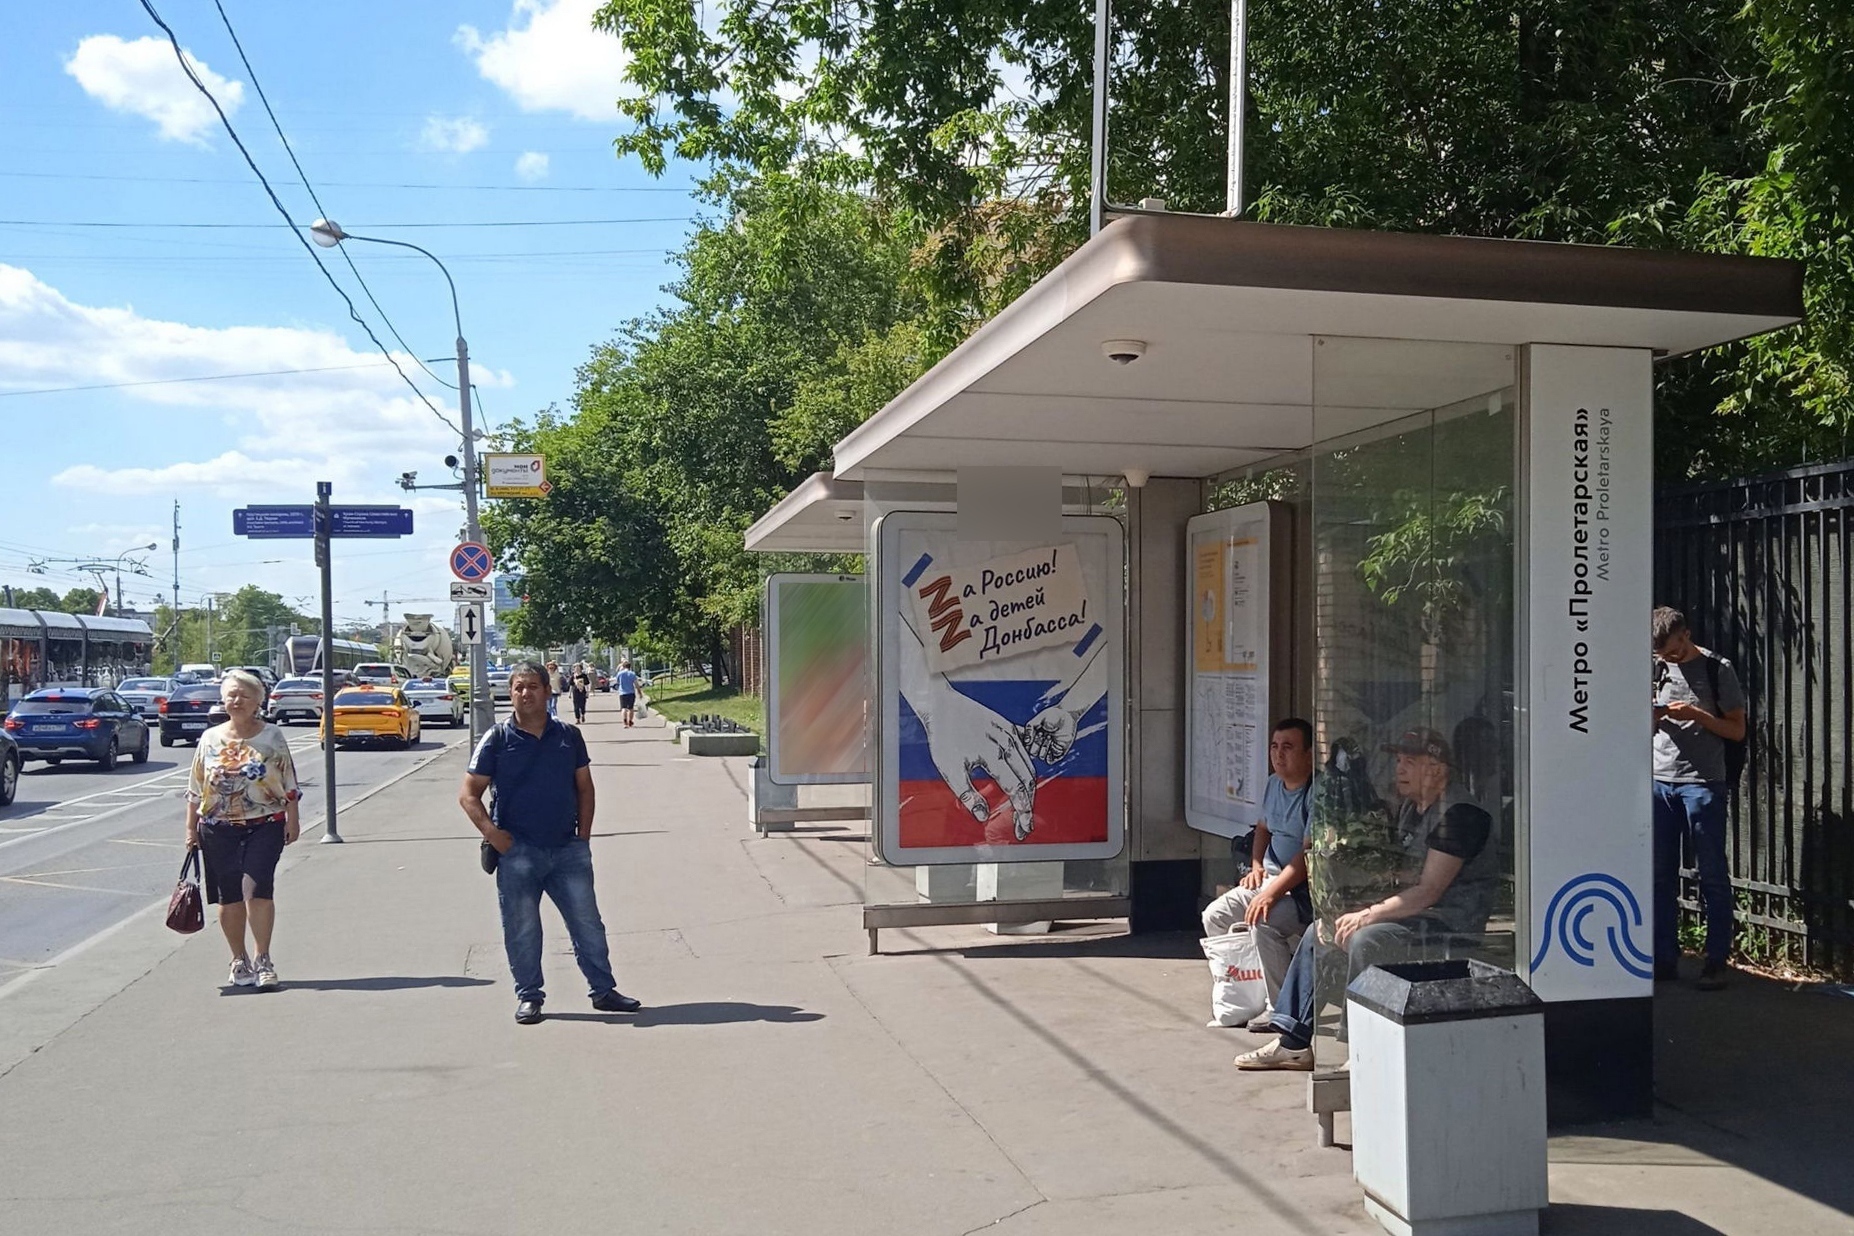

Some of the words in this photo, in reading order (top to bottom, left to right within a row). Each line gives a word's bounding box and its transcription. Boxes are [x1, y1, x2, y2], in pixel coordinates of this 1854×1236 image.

[1596, 408, 1613, 520] Proletarskaya
[1569, 408, 1593, 632] «Пролетарская»
[981, 549, 1058, 595] Россию!
[1596, 528, 1609, 581] Metro
[979, 599, 1087, 660] Донбасса!
[989, 586, 1046, 622] детей
[1569, 642, 1593, 734] Метро
